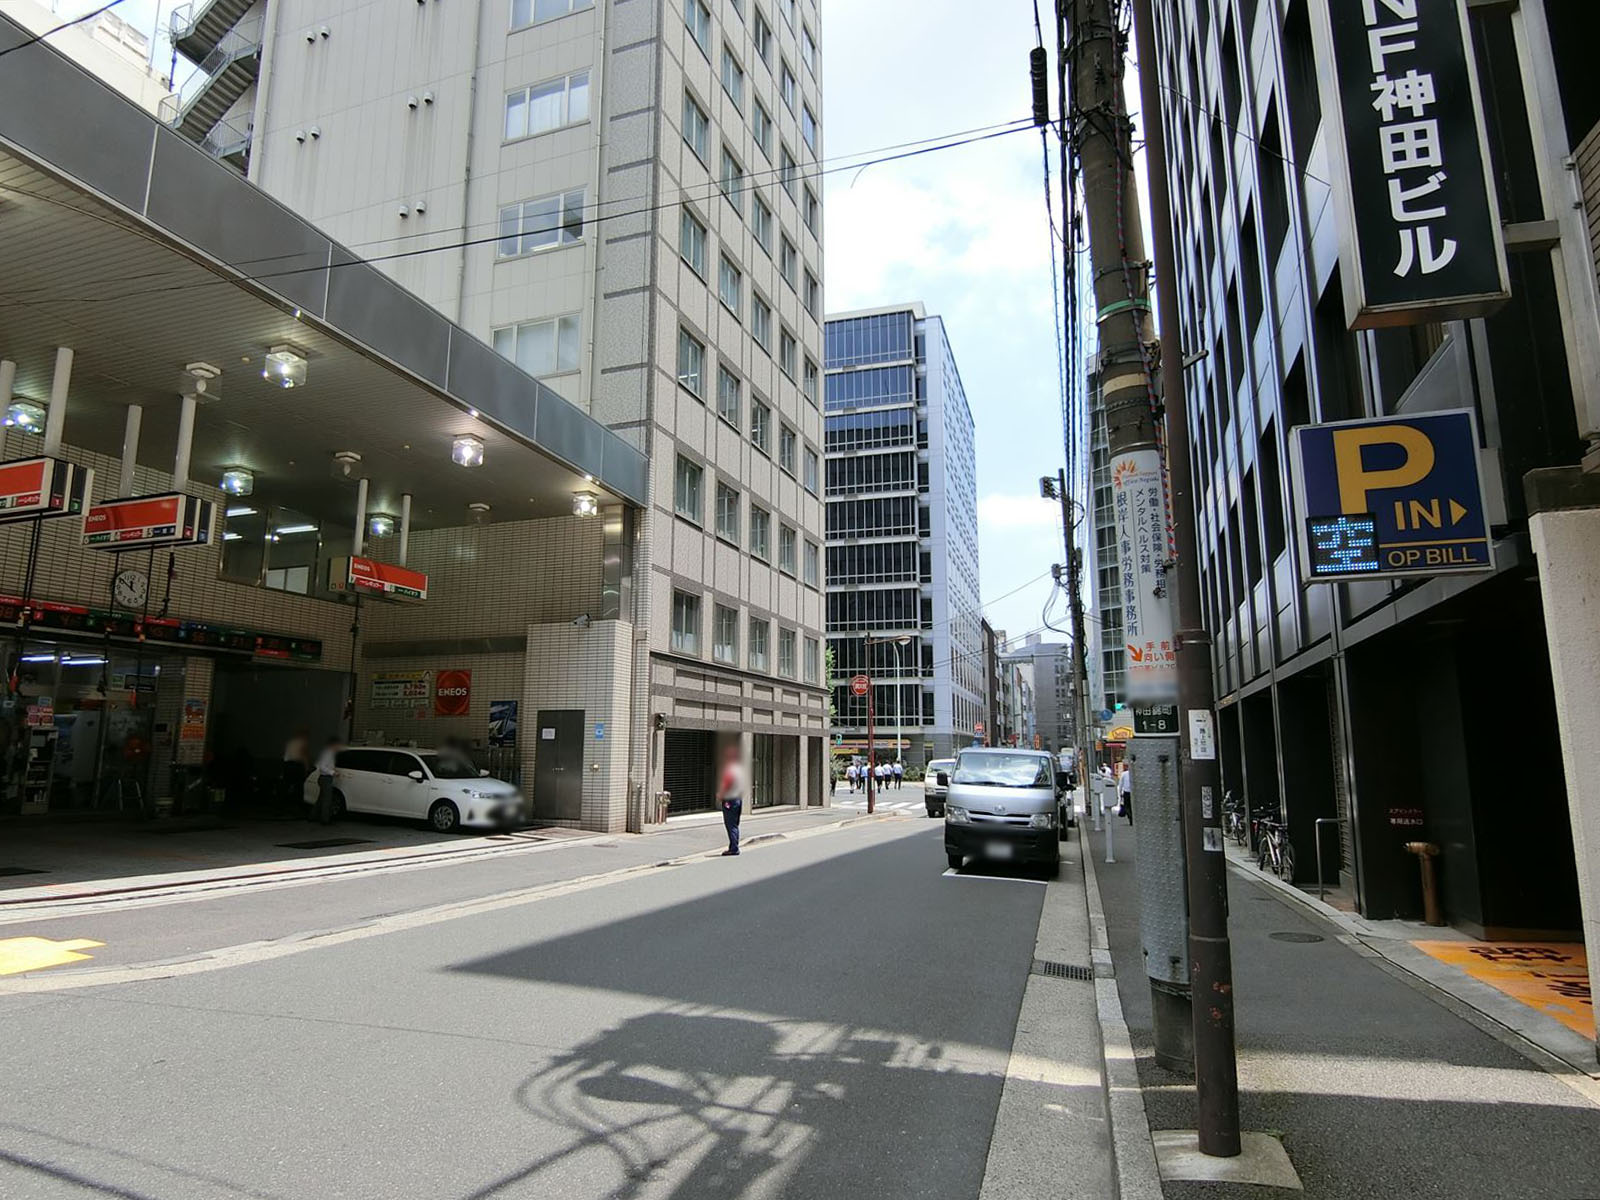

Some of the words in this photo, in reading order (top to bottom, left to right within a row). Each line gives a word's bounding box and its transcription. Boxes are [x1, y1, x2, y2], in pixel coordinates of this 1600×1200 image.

[1332, 424, 1435, 515] P
[87, 513, 106, 523] ENEOS
[1394, 498, 1442, 531] IN
[1135, 488, 1151, 574] メンタルヘルス対策
[1388, 550, 1420, 567] OP
[1426, 546, 1477, 565] BILL
[353, 562, 371, 572] ENEOS
[1116, 491, 1138, 637] 根岸人事労務事務所
[1145, 641, 1170, 650] 手前
[1144, 652, 1175, 662] 向い側
[438, 688, 467, 697] ENEOS
[1142, 719, 1167, 730] 1-8
